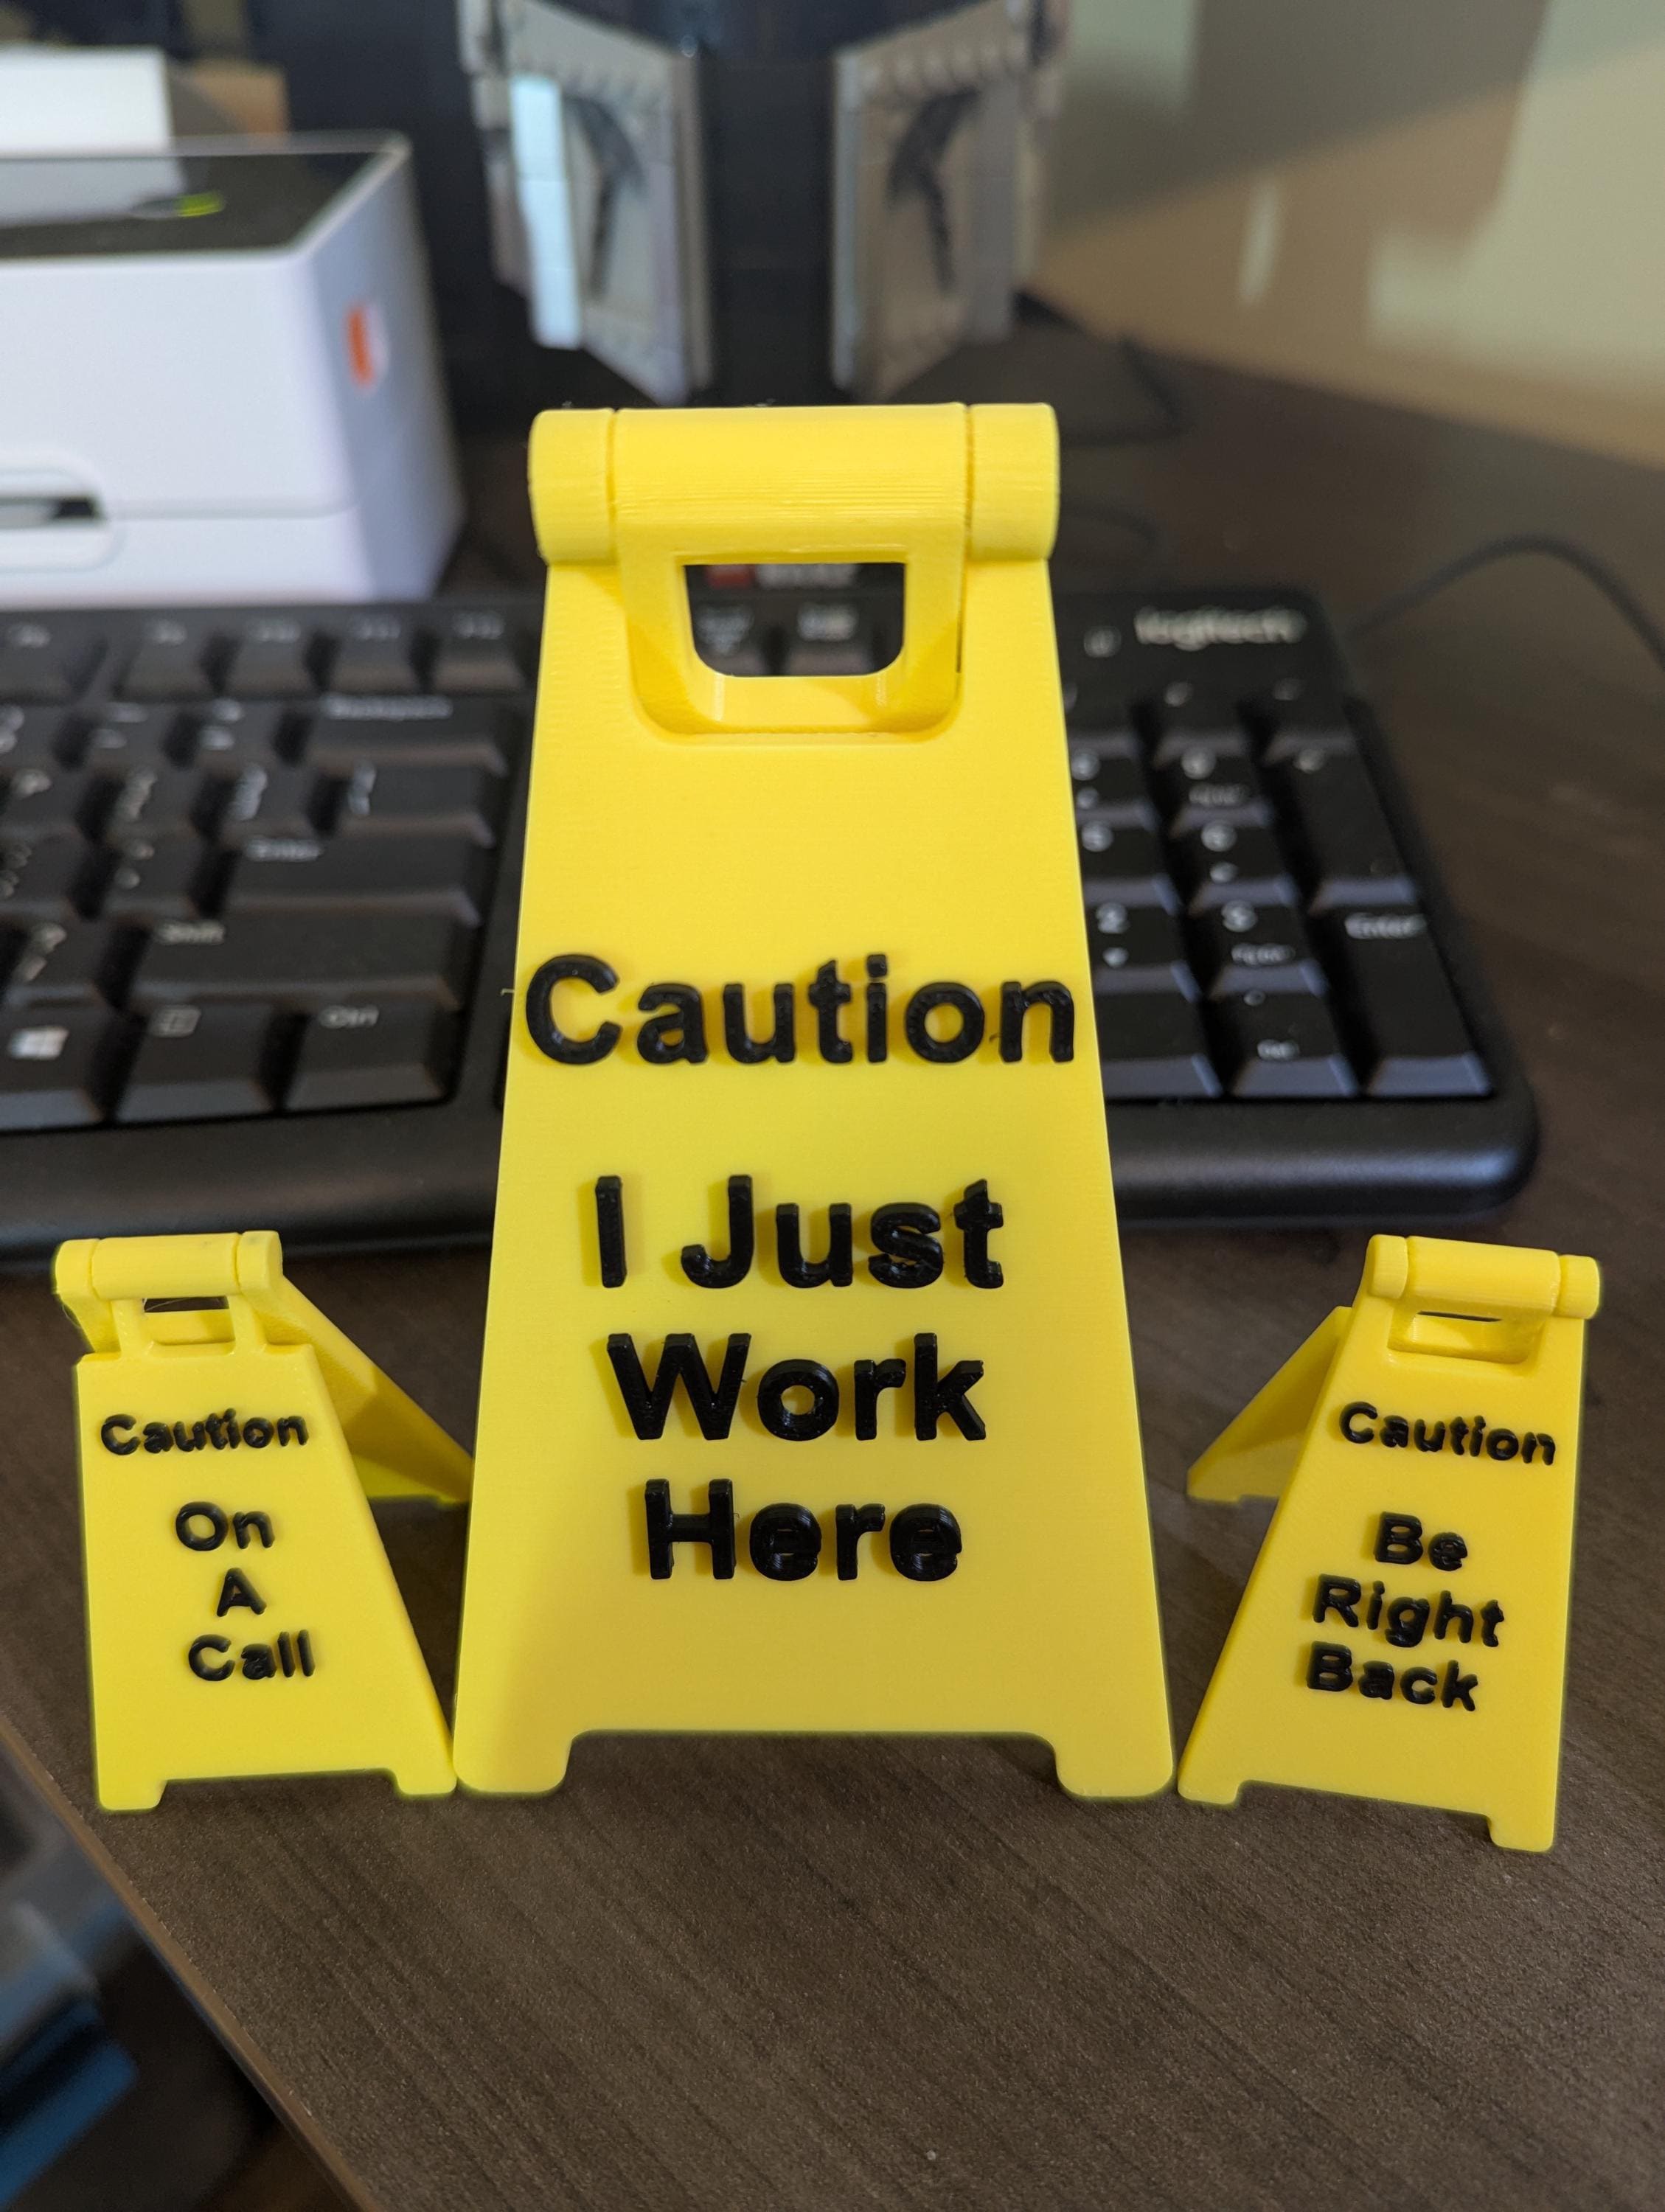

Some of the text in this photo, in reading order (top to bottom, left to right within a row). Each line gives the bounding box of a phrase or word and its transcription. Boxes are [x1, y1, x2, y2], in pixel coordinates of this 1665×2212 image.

[525, 953, 1075, 1065] Caution
[594, 1175, 1004, 1290] I Just
[606, 1332, 987, 1442] Work
[100, 1408, 308, 1455] Caution
[1340, 1401, 1556, 1466] Caution
[175, 1501, 274, 1551] On
[644, 1478, 962, 1582] Here
[1373, 1512, 1468, 1571] Be
[216, 1568, 266, 1618] A
[1311, 1573, 1505, 1648] Right
[188, 1630, 315, 1682] Call
[1306, 1641, 1478, 1711] Back
